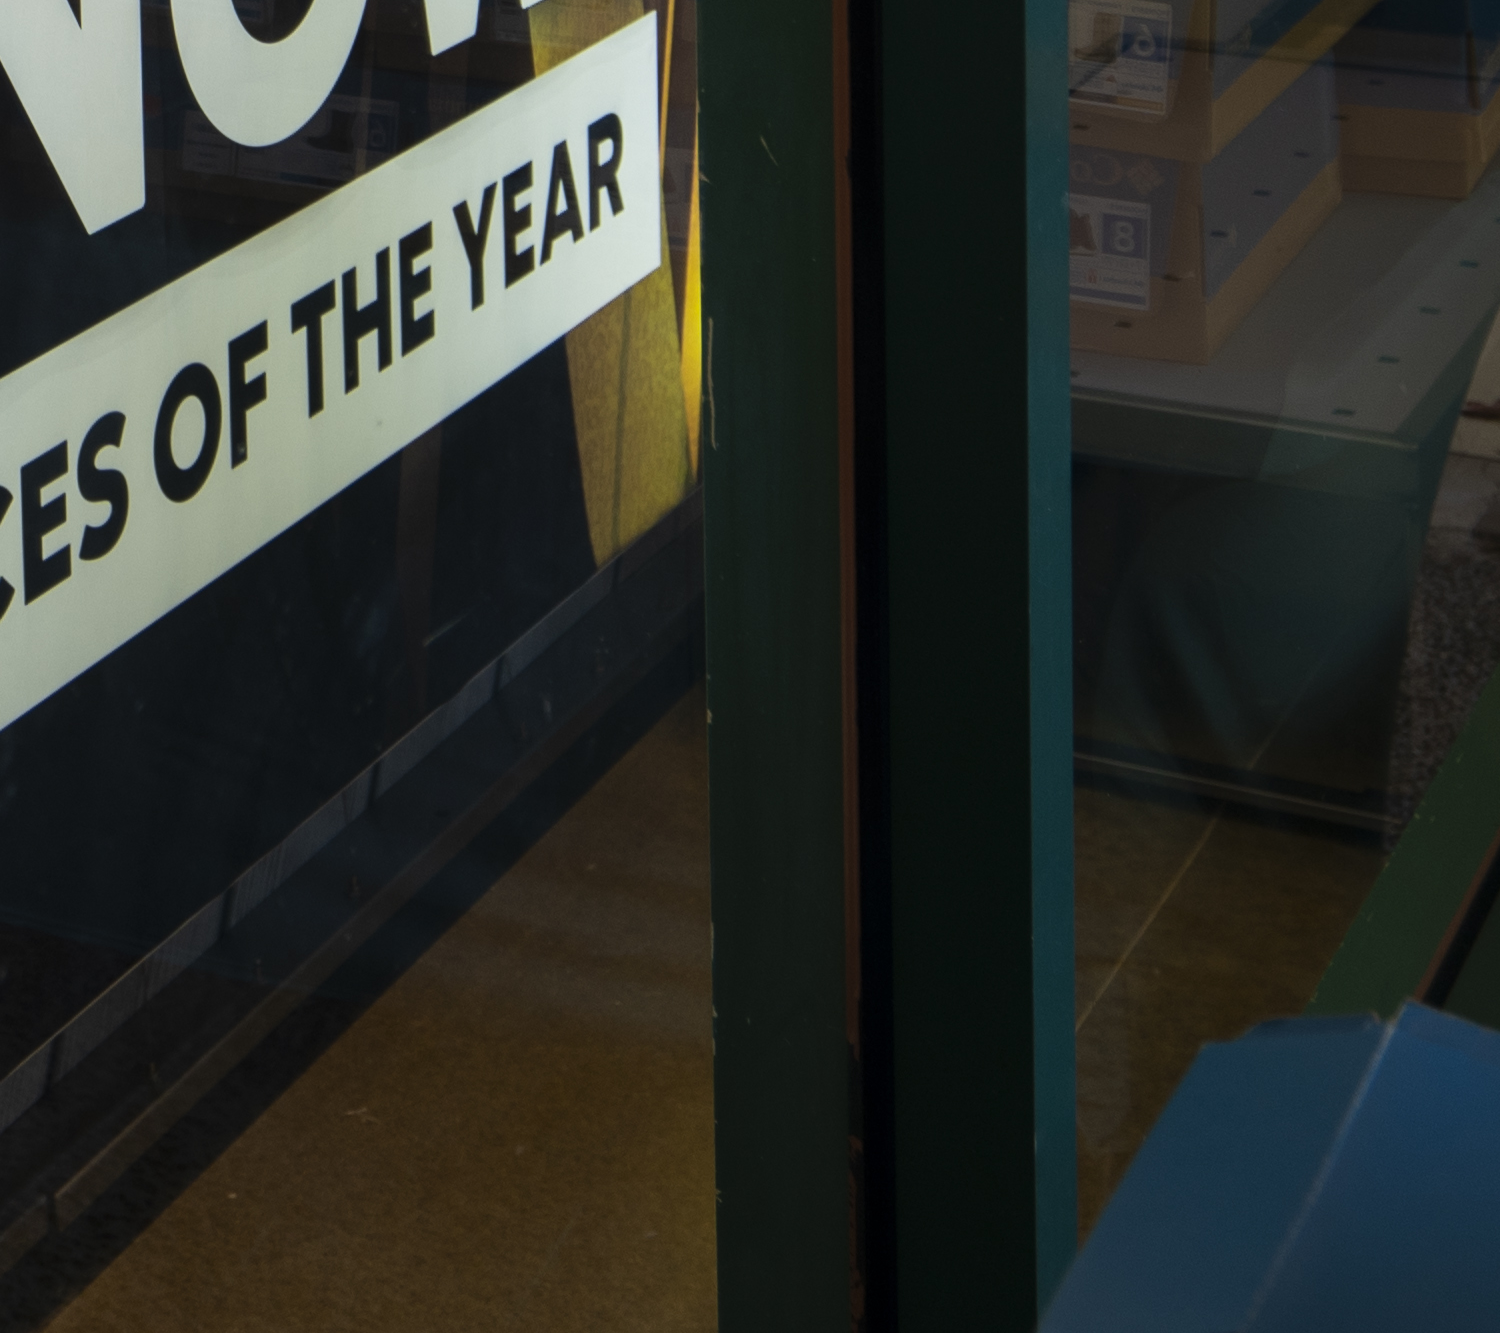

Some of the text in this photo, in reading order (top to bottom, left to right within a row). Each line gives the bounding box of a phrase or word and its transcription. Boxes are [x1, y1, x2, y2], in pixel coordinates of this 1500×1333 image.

[153, 318, 269, 504] OF
[290, 219, 436, 419] THE
[452, 112, 625, 312] YEAR
